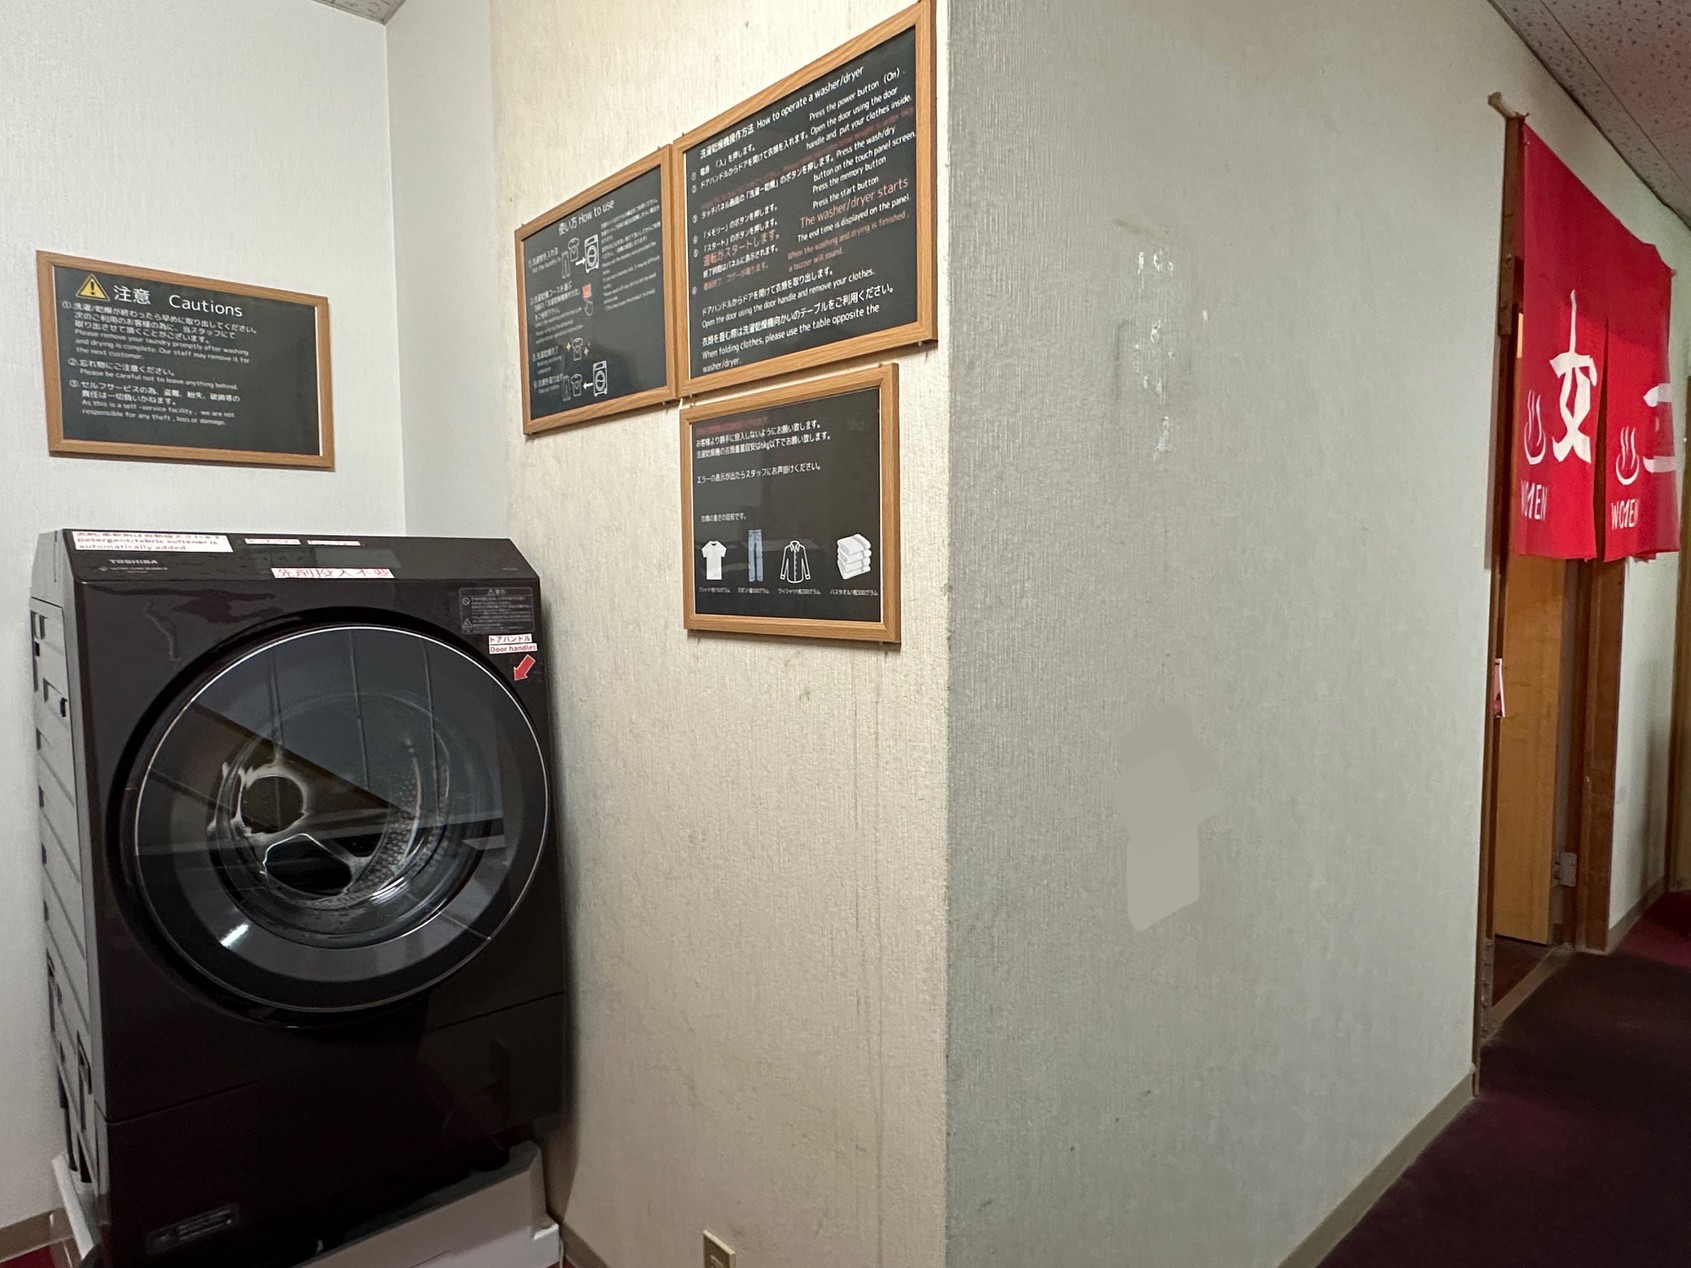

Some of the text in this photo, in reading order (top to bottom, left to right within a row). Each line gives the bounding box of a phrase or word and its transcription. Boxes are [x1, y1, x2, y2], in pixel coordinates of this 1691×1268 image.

[756, 117, 771, 128] How
[772, 112, 780, 121] to
[781, 97, 807, 116] operate
[808, 94, 813, 102] a
[814, 66, 864, 98] washer/dryer
[809, 108, 825, 121] Press
[826, 102, 836, 112] the
[837, 92, 856, 109] power
[857, 81, 879, 97] button
[810, 87, 898, 135] Open the door using the door
[806, 136, 825, 150] handle
[826, 129, 837, 141] and
[839, 123, 850, 136] put
[851, 117, 865, 130] your
[866, 105, 890, 122] clothes
[836, 126, 895, 158] Press the wash/dry
[812, 156, 886, 193] Press the memory button
[813, 168, 834, 182] button
[834, 164, 842, 173] on
[843, 159, 854, 168] the
[855, 149, 873, 163] touch
[874, 140, 891, 157] panel
[800, 178, 908, 228] The washer/dryer starts
[813, 176, 879, 209] Press the start button
[578, 211, 592, 224] How
[593, 206, 602, 217] to
[798, 234, 808, 242] The
[809, 228, 819, 239] end
[820, 224, 834, 234] time
[840, 208, 868, 226] displayed
[869, 206, 878, 215] on
[879, 202, 890, 211] the
[113, 285, 243, 317] 注意 Cautions
[753, 304, 763, 312] the
[763, 300, 776, 309] door
[777, 293, 796, 304] handle
[797, 288, 808, 298] and
[809, 282, 832, 294] remove
[833, 277, 847, 289] your
[702, 350, 718, 359] When
[719, 344, 739, 355] folding
[765, 331, 785, 344] please
[786, 327, 798, 337] use
[799, 323, 811, 333] the
[812, 317, 831, 329] table
[832, 308, 864, 325] opposite
[866, 304, 880, 315] the
[1549, 289, 1598, 464] 女
[490, 644, 537, 653] Door handles
